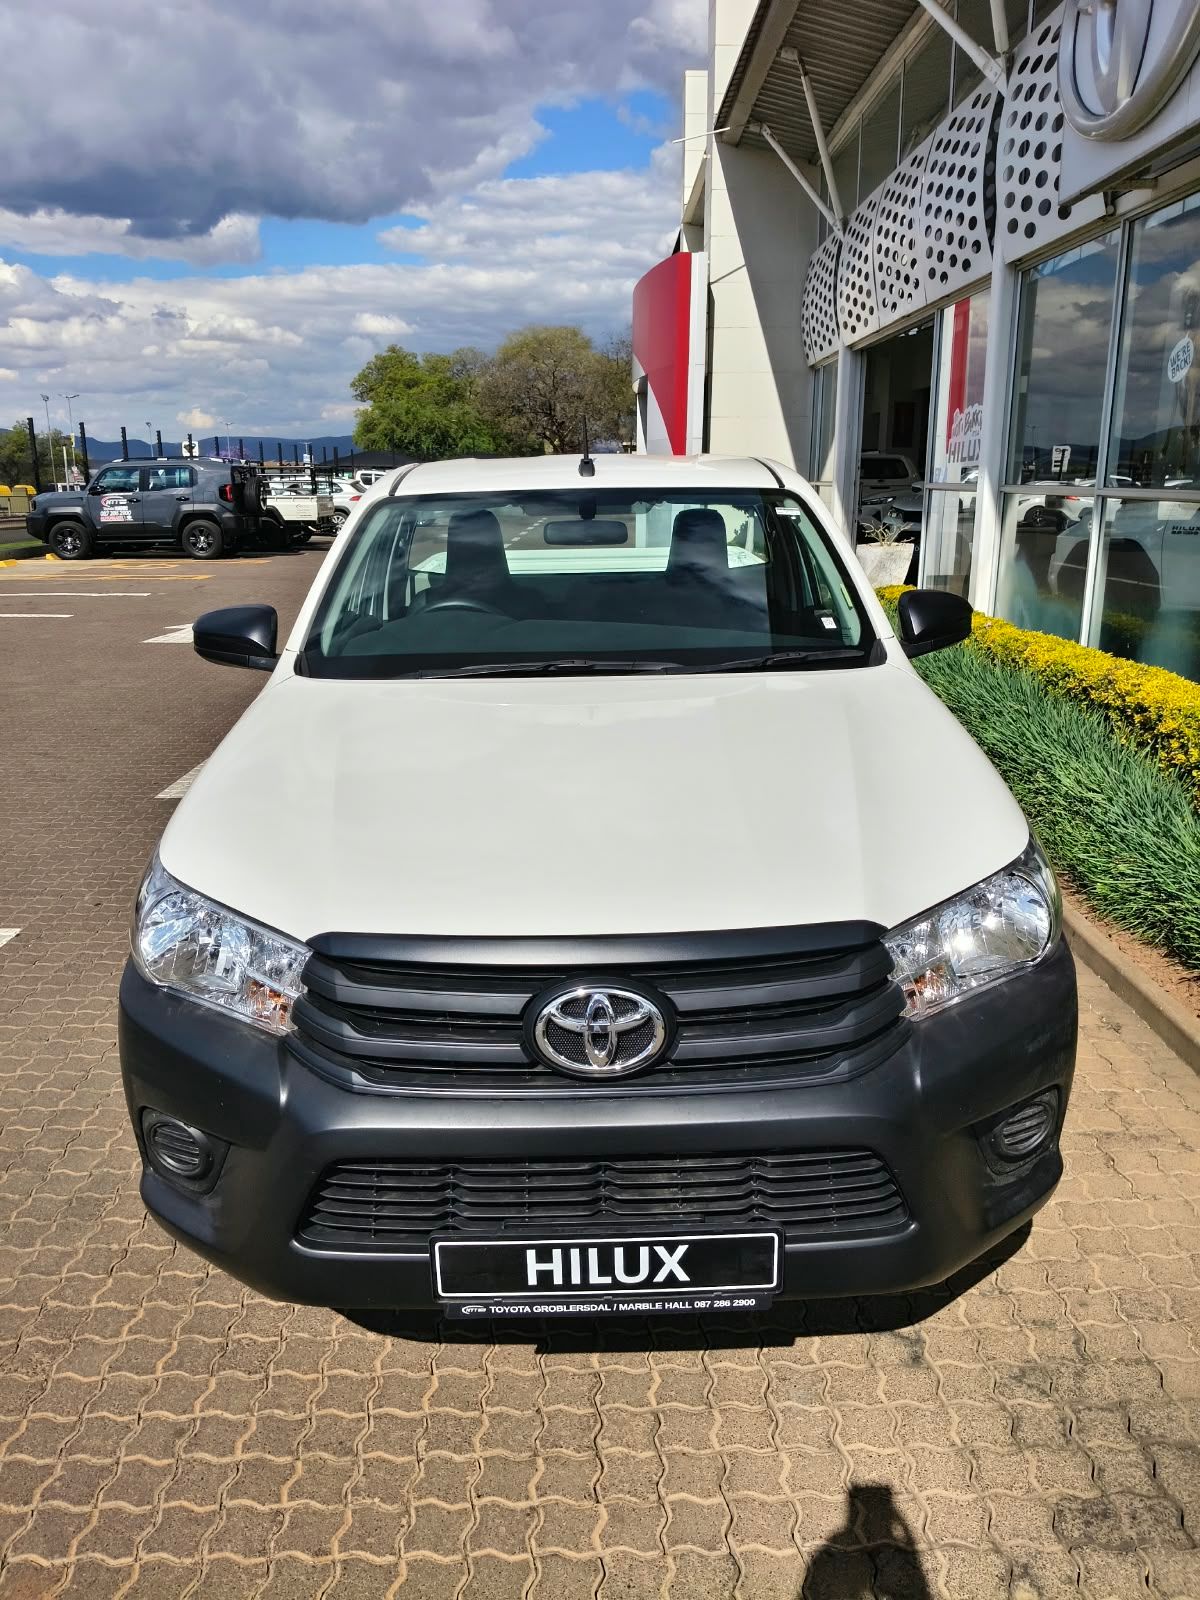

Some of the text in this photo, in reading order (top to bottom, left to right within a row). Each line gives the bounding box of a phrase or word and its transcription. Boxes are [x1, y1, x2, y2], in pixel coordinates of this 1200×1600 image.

[1170, 341, 1191, 367] WE'RE
[1171, 353, 1191, 379] BACK!
[526, 1244, 691, 1286] HILUX
[489, 1305, 531, 1313] TOYOTA
[533, 1304, 611, 1313] GROBLERSDAL
[619, 1302, 663, 1311] MARBLE
[665, 1301, 692, 1309] HALL
[694, 1300, 711, 1308] 087
[733, 1298, 756, 1307] 2900
